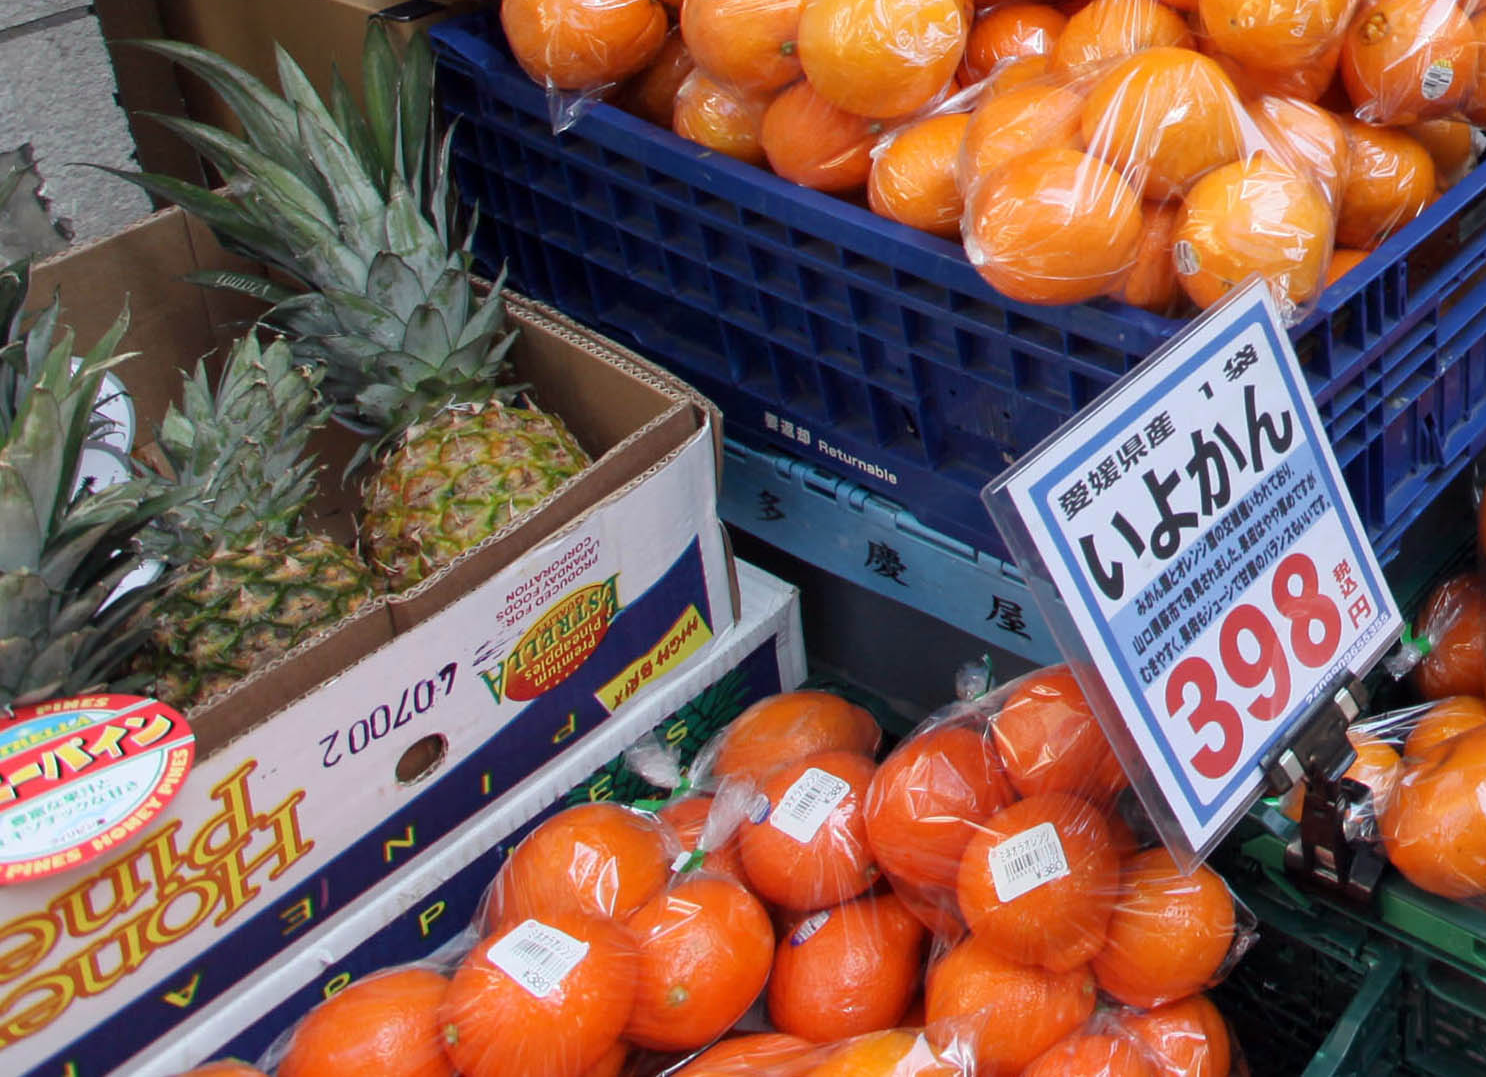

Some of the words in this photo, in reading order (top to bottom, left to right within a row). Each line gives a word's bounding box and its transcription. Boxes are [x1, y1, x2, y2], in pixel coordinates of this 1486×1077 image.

[818, 439, 898, 485] Returnable
[1056, 409, 1177, 522] 愛媛県産
[1078, 383, 1295, 601] いよかん
[505, 535, 593, 604] CORPORATION
[536, 552, 600, 607] PRODUCED
[542, 538, 601, 593] LAPANDAY
[1332, 558, 1360, 601] 税込
[1348, 600, 1372, 632] 円
[495, 589, 542, 623] FOODS
[481, 570, 625, 706] ESTRELLA
[523, 616, 602, 682] Pineapples
[533, 634, 597, 688] Premium
[1165, 552, 1343, 780] 398
[158, 748, 189, 795] PINES
[91, 795, 163, 851] HONEY
[6, 848, 83, 879] PINES
[0, 789, 315, 1052] Hone
